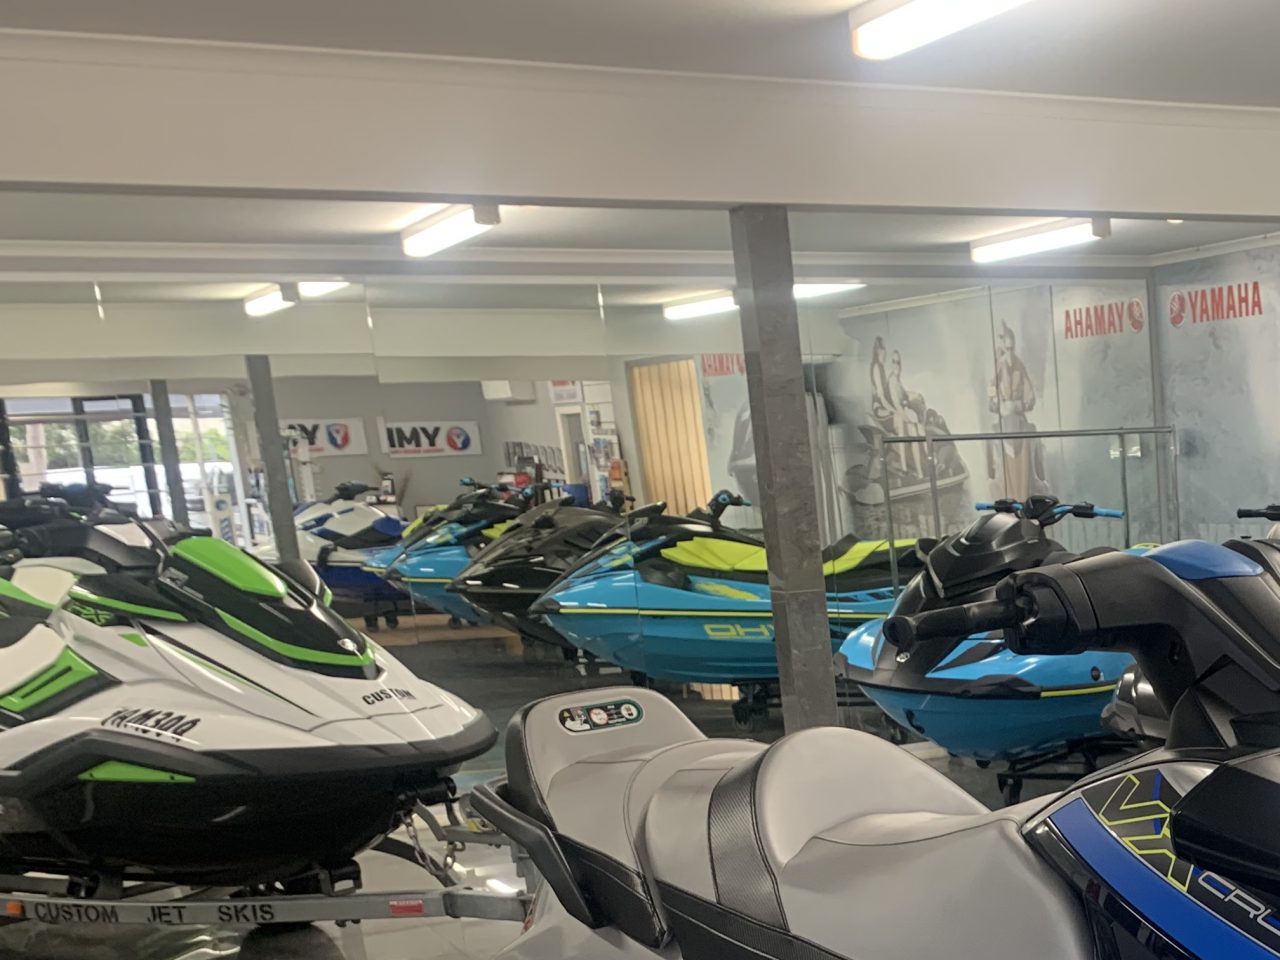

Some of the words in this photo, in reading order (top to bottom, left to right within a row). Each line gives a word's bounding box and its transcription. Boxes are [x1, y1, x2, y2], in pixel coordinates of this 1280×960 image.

[1188, 281, 1263, 323] YAMAHA
[34, 902, 119, 924] CUSTOM
[147, 905, 187, 924] JET
[218, 903, 275, 923] SKIS
